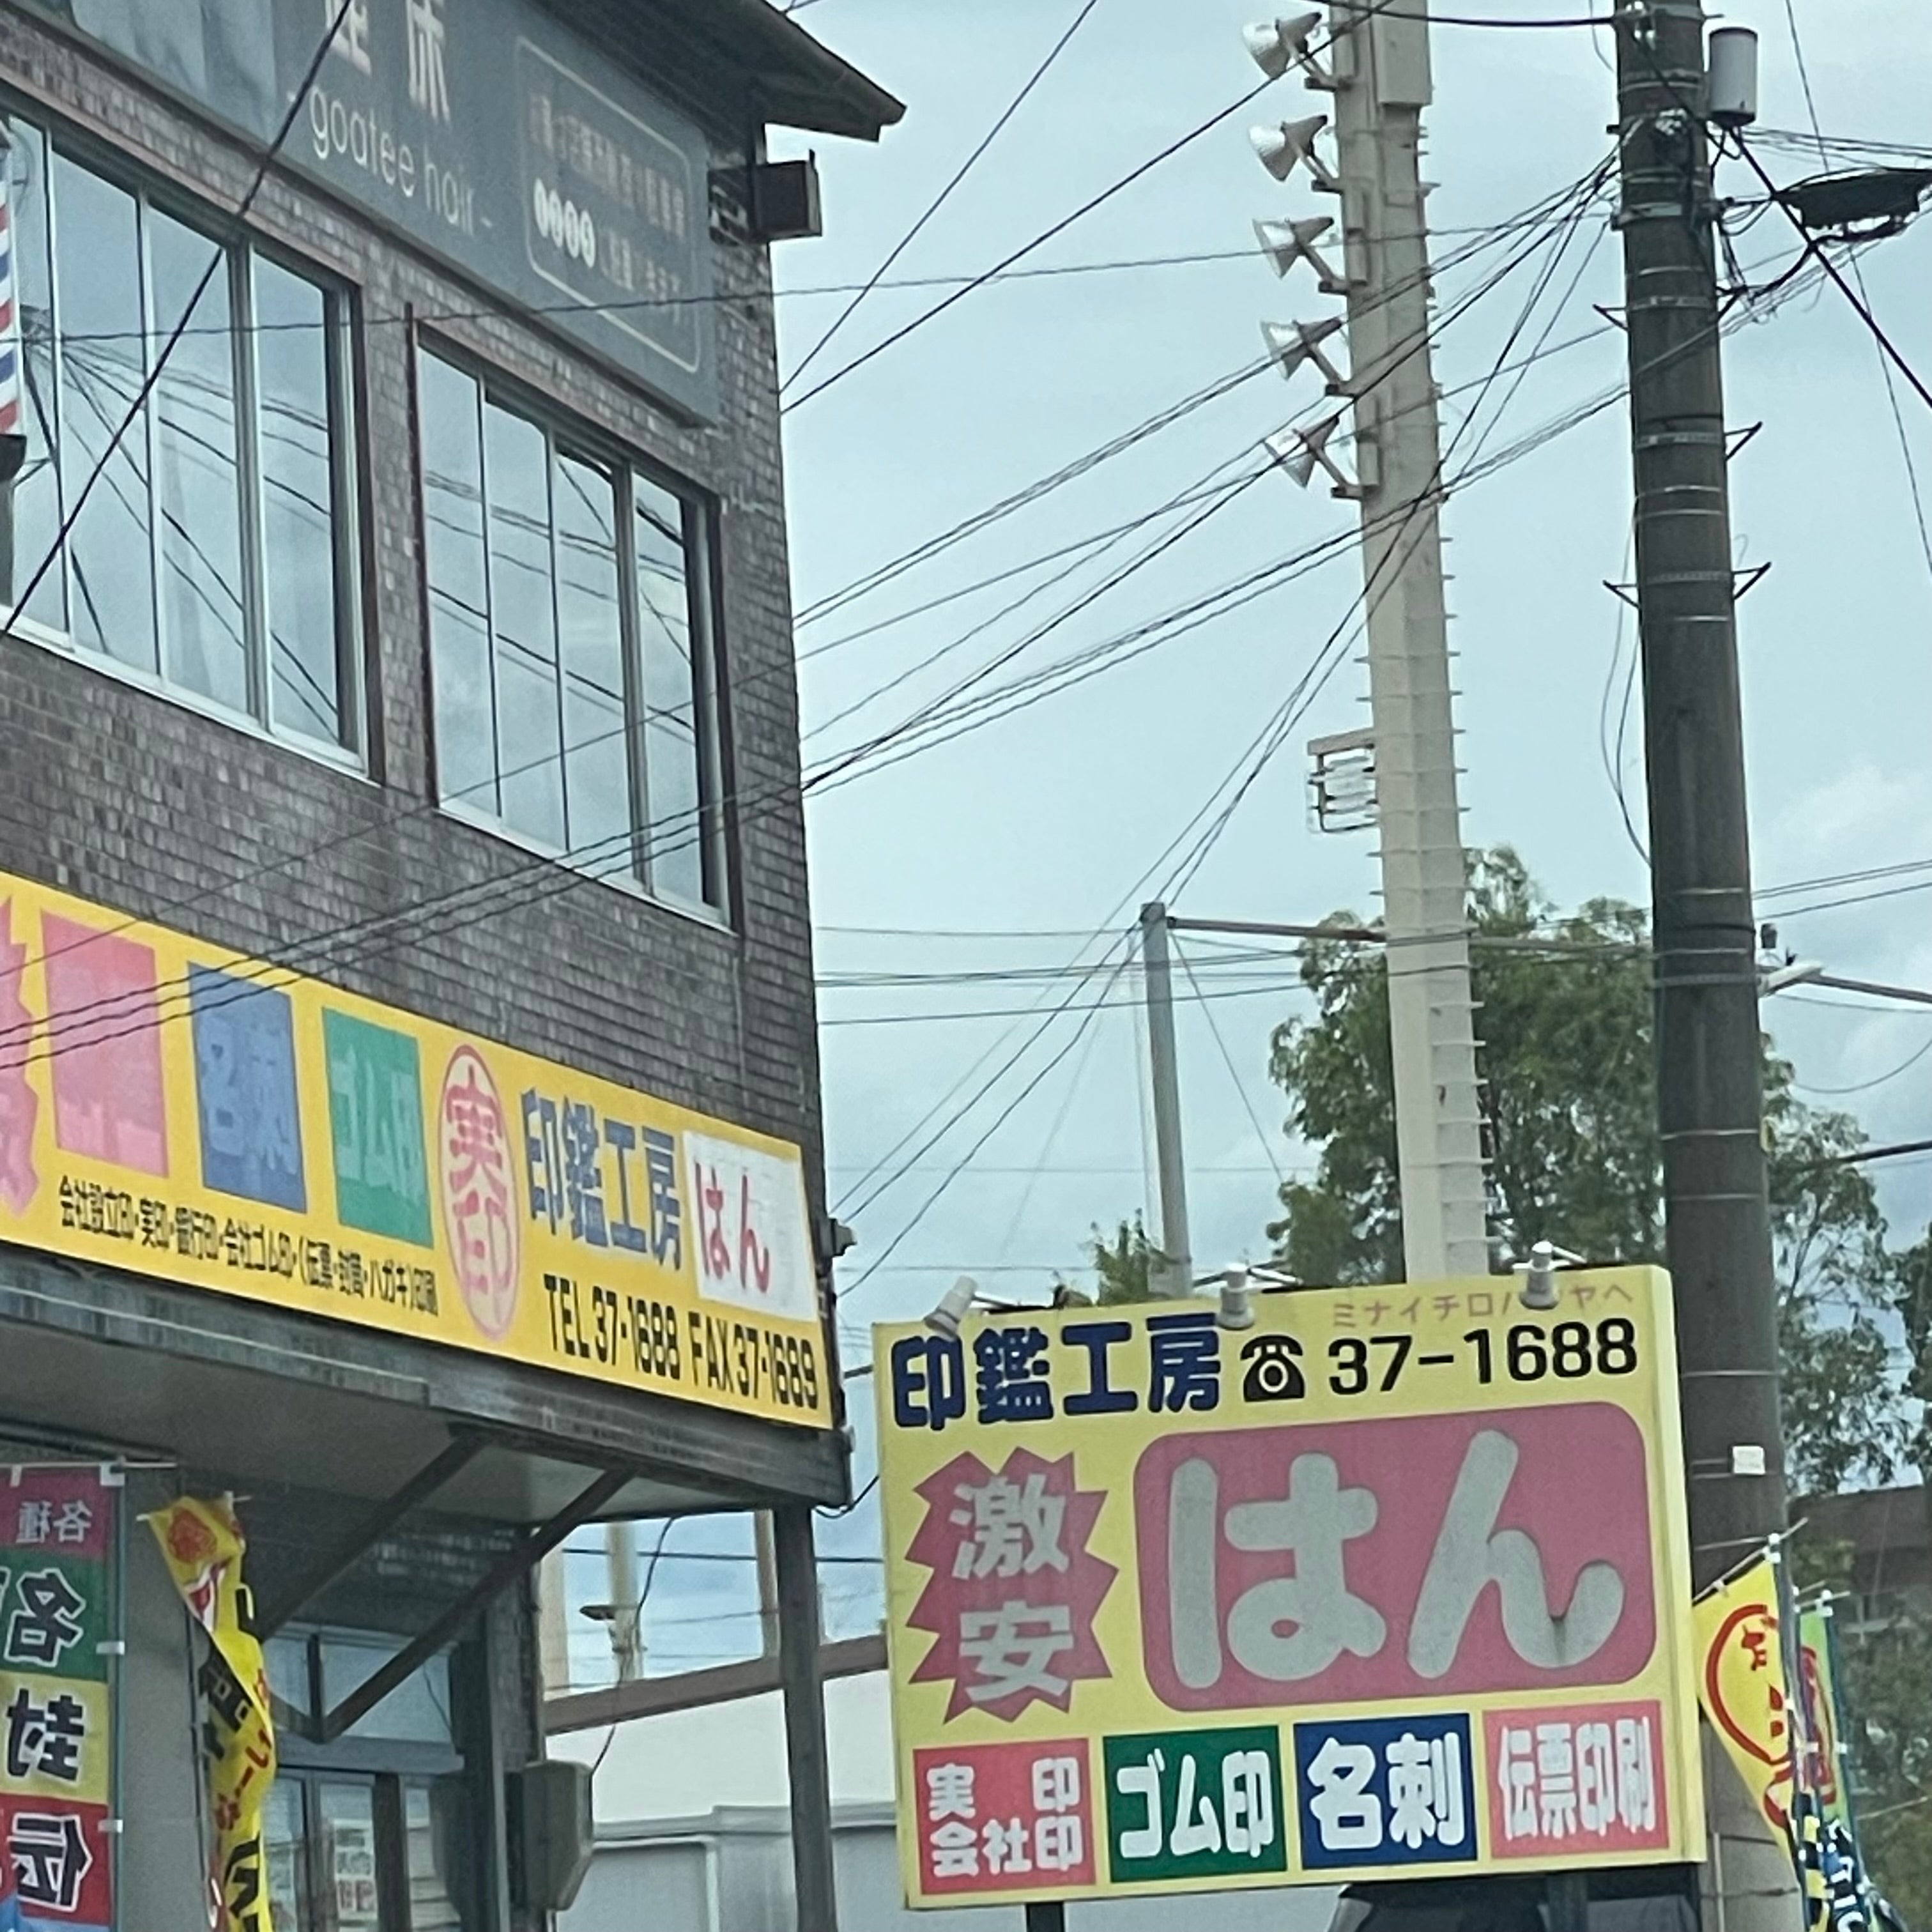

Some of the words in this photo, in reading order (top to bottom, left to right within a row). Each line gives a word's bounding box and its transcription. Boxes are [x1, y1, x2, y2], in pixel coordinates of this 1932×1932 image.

[309, 85, 416, 198] goatee
[424, 142, 474, 238] hair
[447, 1063, 512, 1325] 実印
[521, 1087, 682, 1271] 印鑑工房
[694, 1160, 770, 1294] はん
[543, 1273, 590, 1359] TEL
[592, 1285, 680, 1381] 37-1688
[687, 1310, 734, 1394] FAX
[733, 1322, 818, 1411] 37-1689
[891, 1312, 1222, 1432] 印鑑工房
[1328, 1317, 1638, 1396] 37-1688
[951, 1472, 1076, 1705] 激安
[1169, 1428, 1625, 1690] はん
[930, 1814, 1085, 1878] 会社印
[1116, 1747, 1275, 1860] ゴム印
[1307, 1731, 1466, 1850] 名刺
[1498, 1715, 1657, 1843] 伝票印刷
